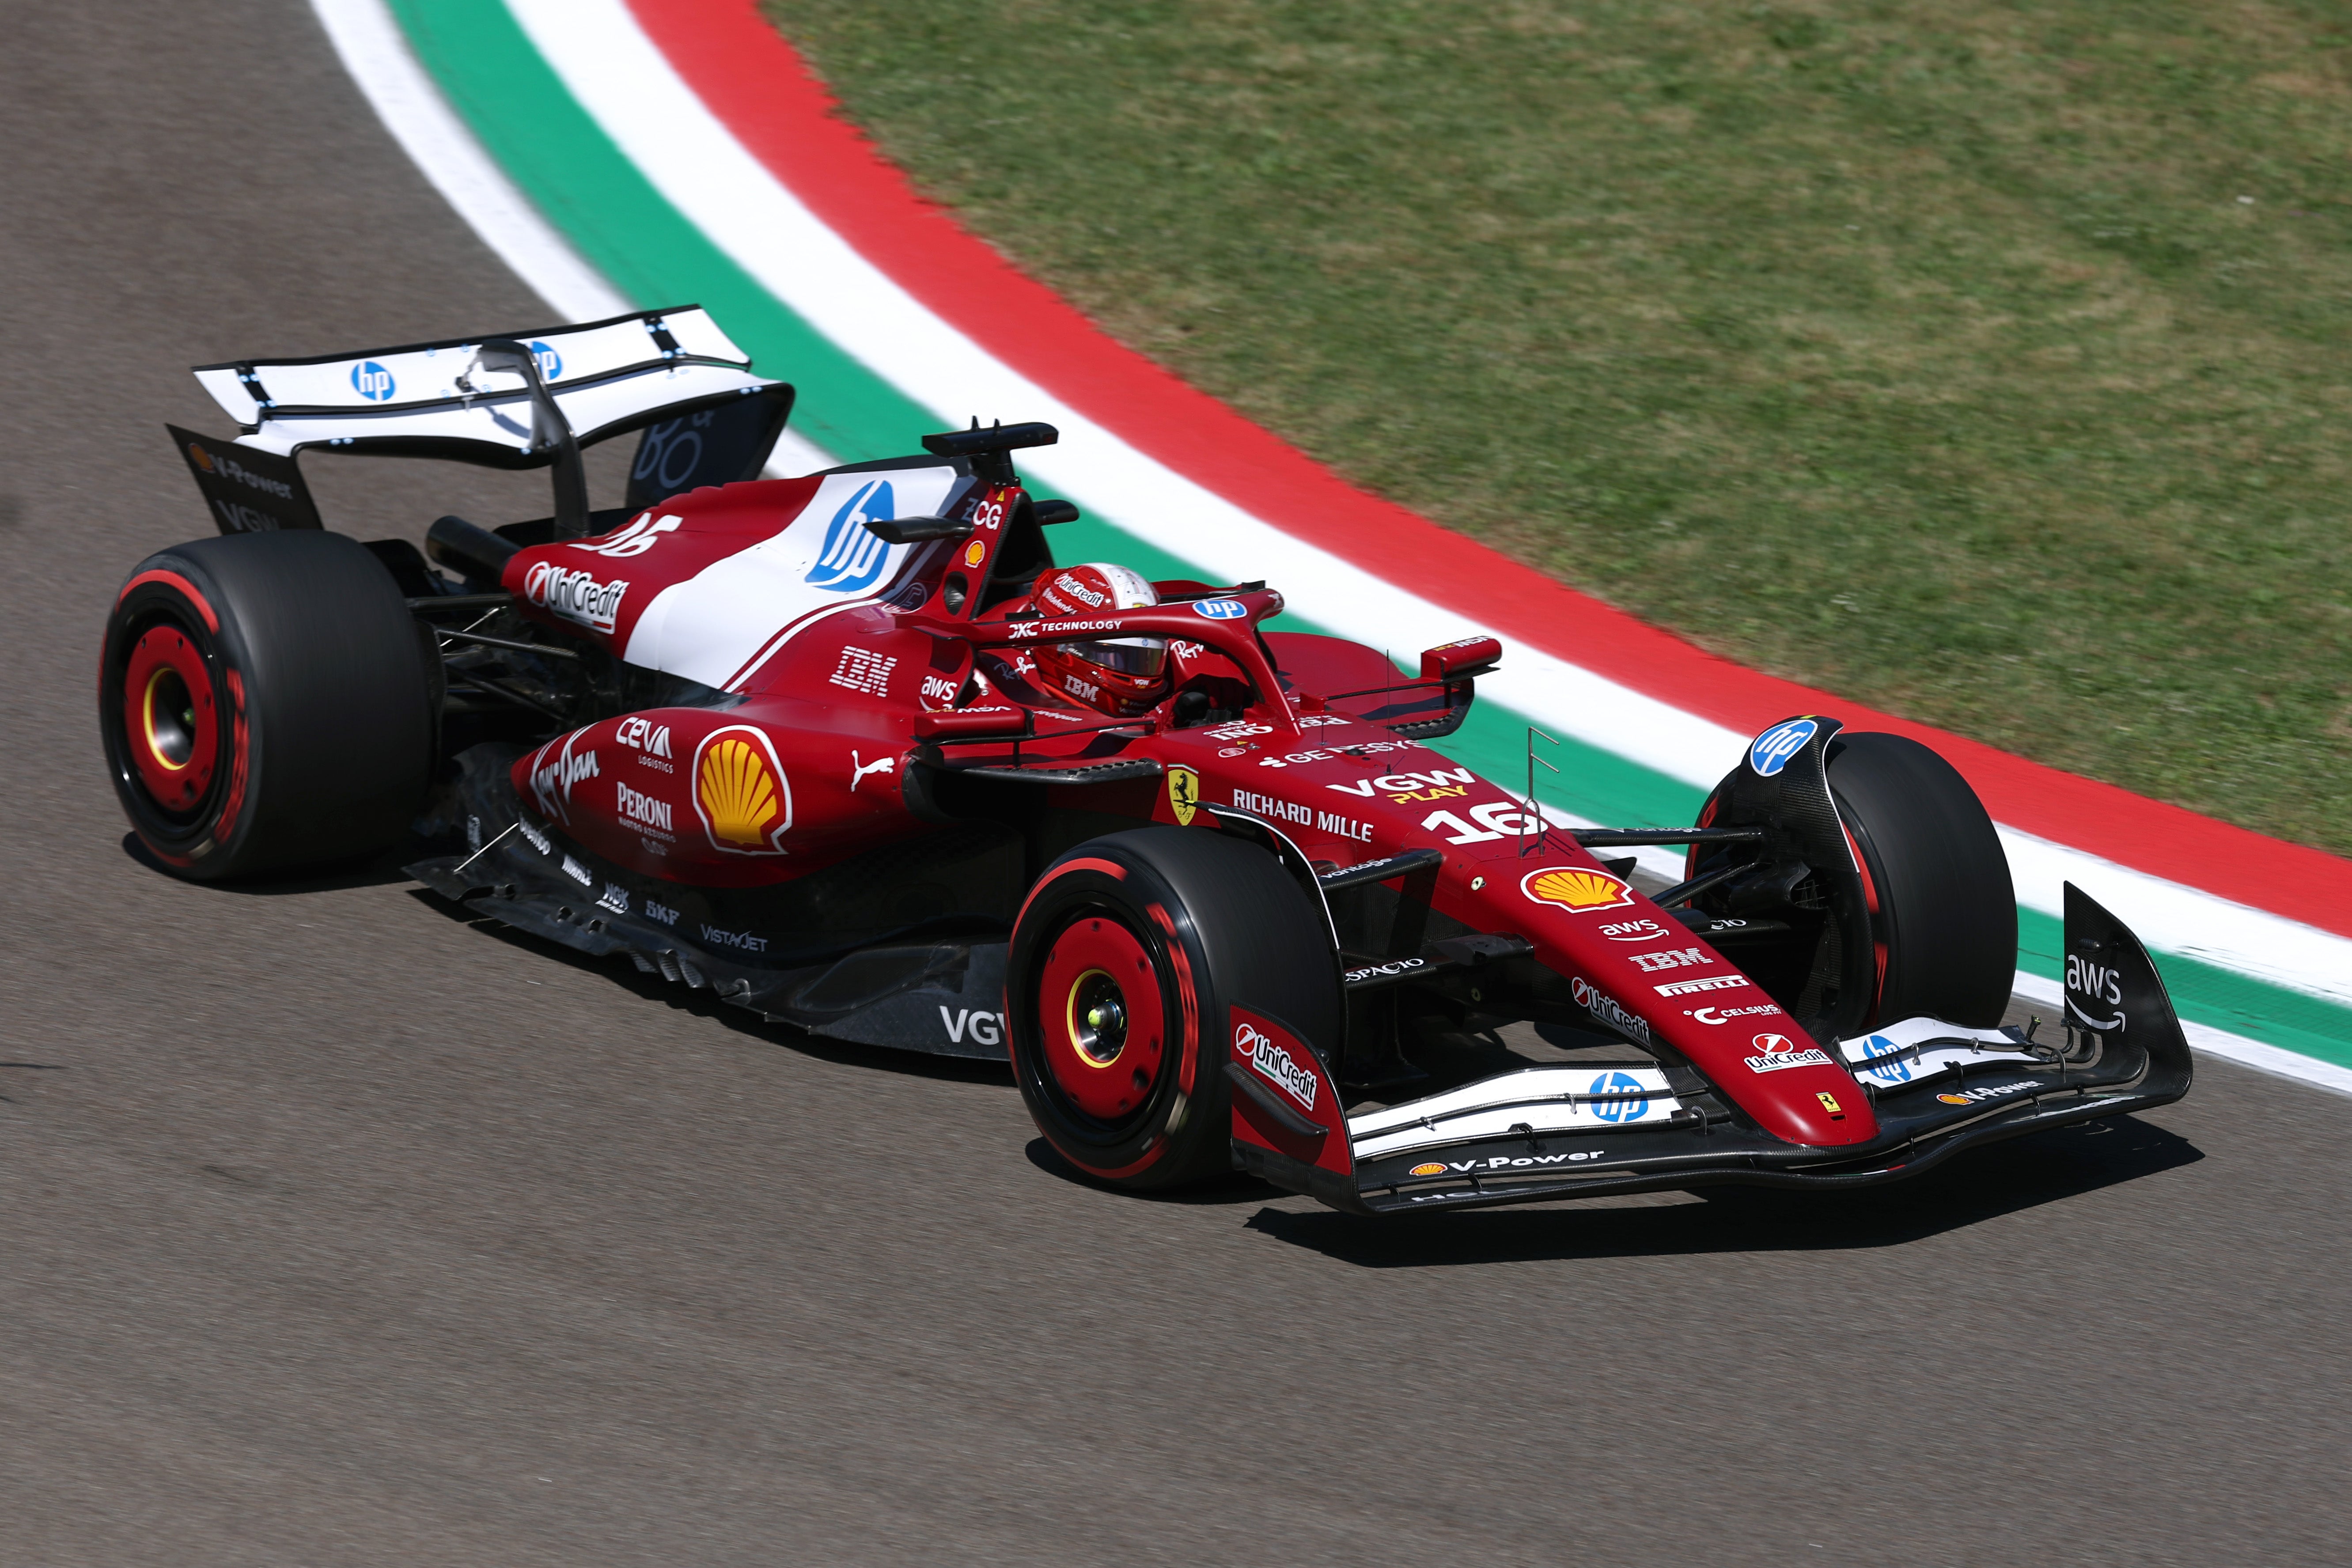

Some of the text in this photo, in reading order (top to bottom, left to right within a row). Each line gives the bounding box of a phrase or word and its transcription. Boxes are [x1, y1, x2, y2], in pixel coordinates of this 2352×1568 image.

[355, 361, 393, 401] hp
[567, 512, 683, 557] 16
[806, 480, 894, 592] hp
[548, 566, 629, 618] UniCredit
[1060, 575, 1104, 607] UniCredit
[1202, 600, 1241, 619] hp
[1041, 620, 1122, 632] TECHNOLOGY
[829, 645, 898, 697] IBM
[920, 675, 958, 701] aws
[1064, 674, 1099, 702] IBM
[1752, 719, 1816, 776] hp
[637, 754, 674, 774] LOGISTICS
[1325, 768, 1476, 797] VGW
[1387, 785, 1469, 805] PLAY
[617, 781, 673, 831] PERONI
[1233, 788, 1374, 843] RICHARD MILLE
[1420, 802, 1549, 845] 16
[1320, 858, 1393, 879] vantage
[646, 900, 680, 926] SKF
[1598, 918, 1660, 937] aws
[1345, 958, 1424, 981] SPACIO
[1628, 947, 1714, 973] IBM
[1653, 974, 1750, 998] PIRELLI
[2067, 954, 2121, 1005] aws
[1591, 988, 1649, 1042] UniCredit
[1256, 1036, 1317, 1101] UniCredit
[1746, 1048, 1829, 1068] UniCredit
[1865, 1035, 1909, 1082] hp
[1594, 1072, 1646, 1123] hp
[1957, 1080, 2045, 1100] V-Power
[1449, 1150, 1605, 1173] V-Power
